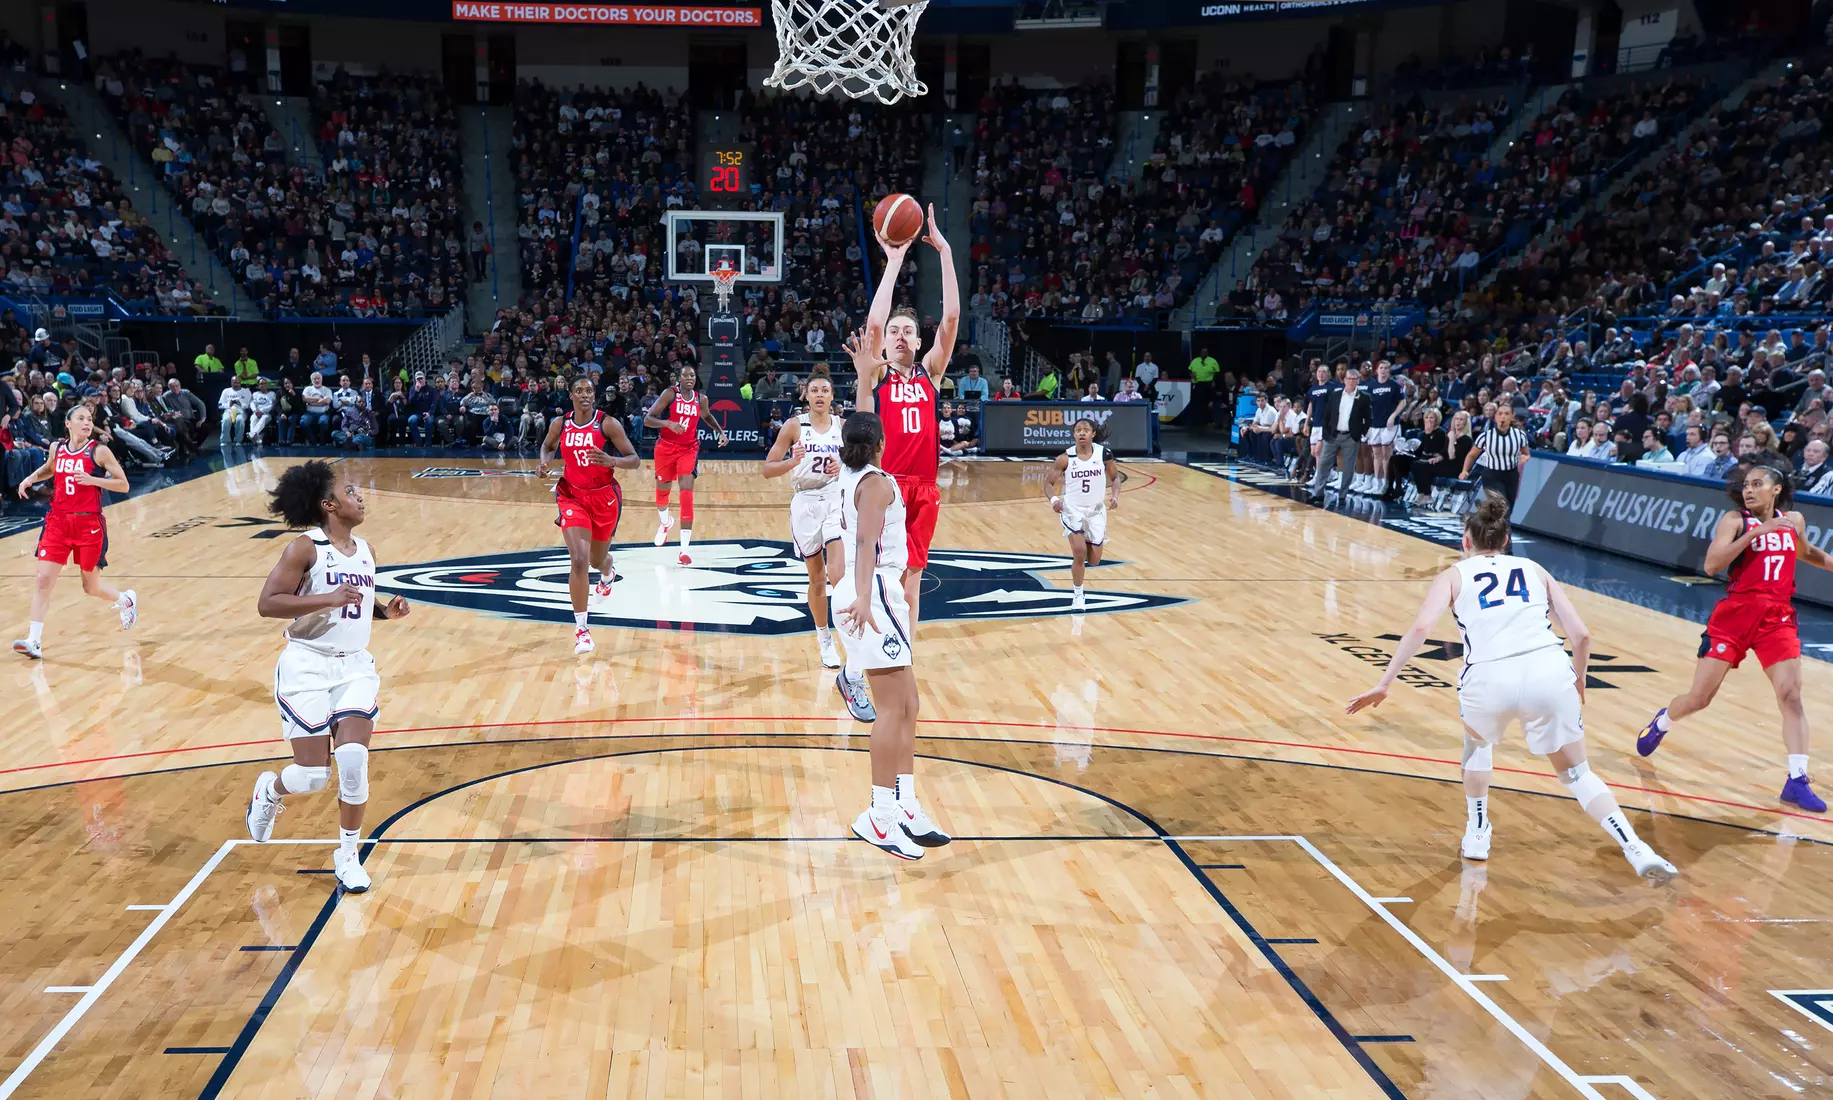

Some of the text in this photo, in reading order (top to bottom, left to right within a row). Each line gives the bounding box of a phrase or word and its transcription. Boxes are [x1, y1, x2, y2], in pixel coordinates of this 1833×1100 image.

[456, 4, 759, 24] MAKE THEIR DOCTORS YOUR DOCTORS.
[1201, 4, 1240, 16] UCONN
[1243, 4, 1275, 12] HEALTH
[1280, 1, 1332, 10] ORTHOPEDICS
[1640, 12, 1660, 25] 112
[715, 151, 742, 165] 7:52
[711, 167, 739, 192] 20
[69, 304, 103, 314] BUD LIGHT
[1321, 316, 1353, 324] BUD LIGHT
[890, 382, 929, 404] USA
[1312, 388, 1327, 396] UCONN
[1373, 387, 1391, 395] UCONN
[676, 402, 698, 417] USA
[679, 416, 691, 432] 14
[901, 407, 921, 434] 10
[565, 432, 594, 447] USA
[1023, 427, 1071, 438] Delivers
[1023, 438, 1046, 447] Delivery
[1047, 438, 1071, 446] available
[55, 458, 85, 473] USA
[573, 449, 589, 467] 13
[1070, 469, 1102, 479] UCONN
[65, 476, 75, 495] 6
[1081, 479, 1091, 493] 5
[1557, 480, 1600, 512] OUR
[1599, 489, 1696, 534] HUSKIES
[1750, 531, 1796, 552] USA
[1763, 555, 1786, 581] 17
[325, 572, 375, 589] UCONN
[1473, 567, 1530, 611] 24
[1311, 632, 1361, 645] XL
